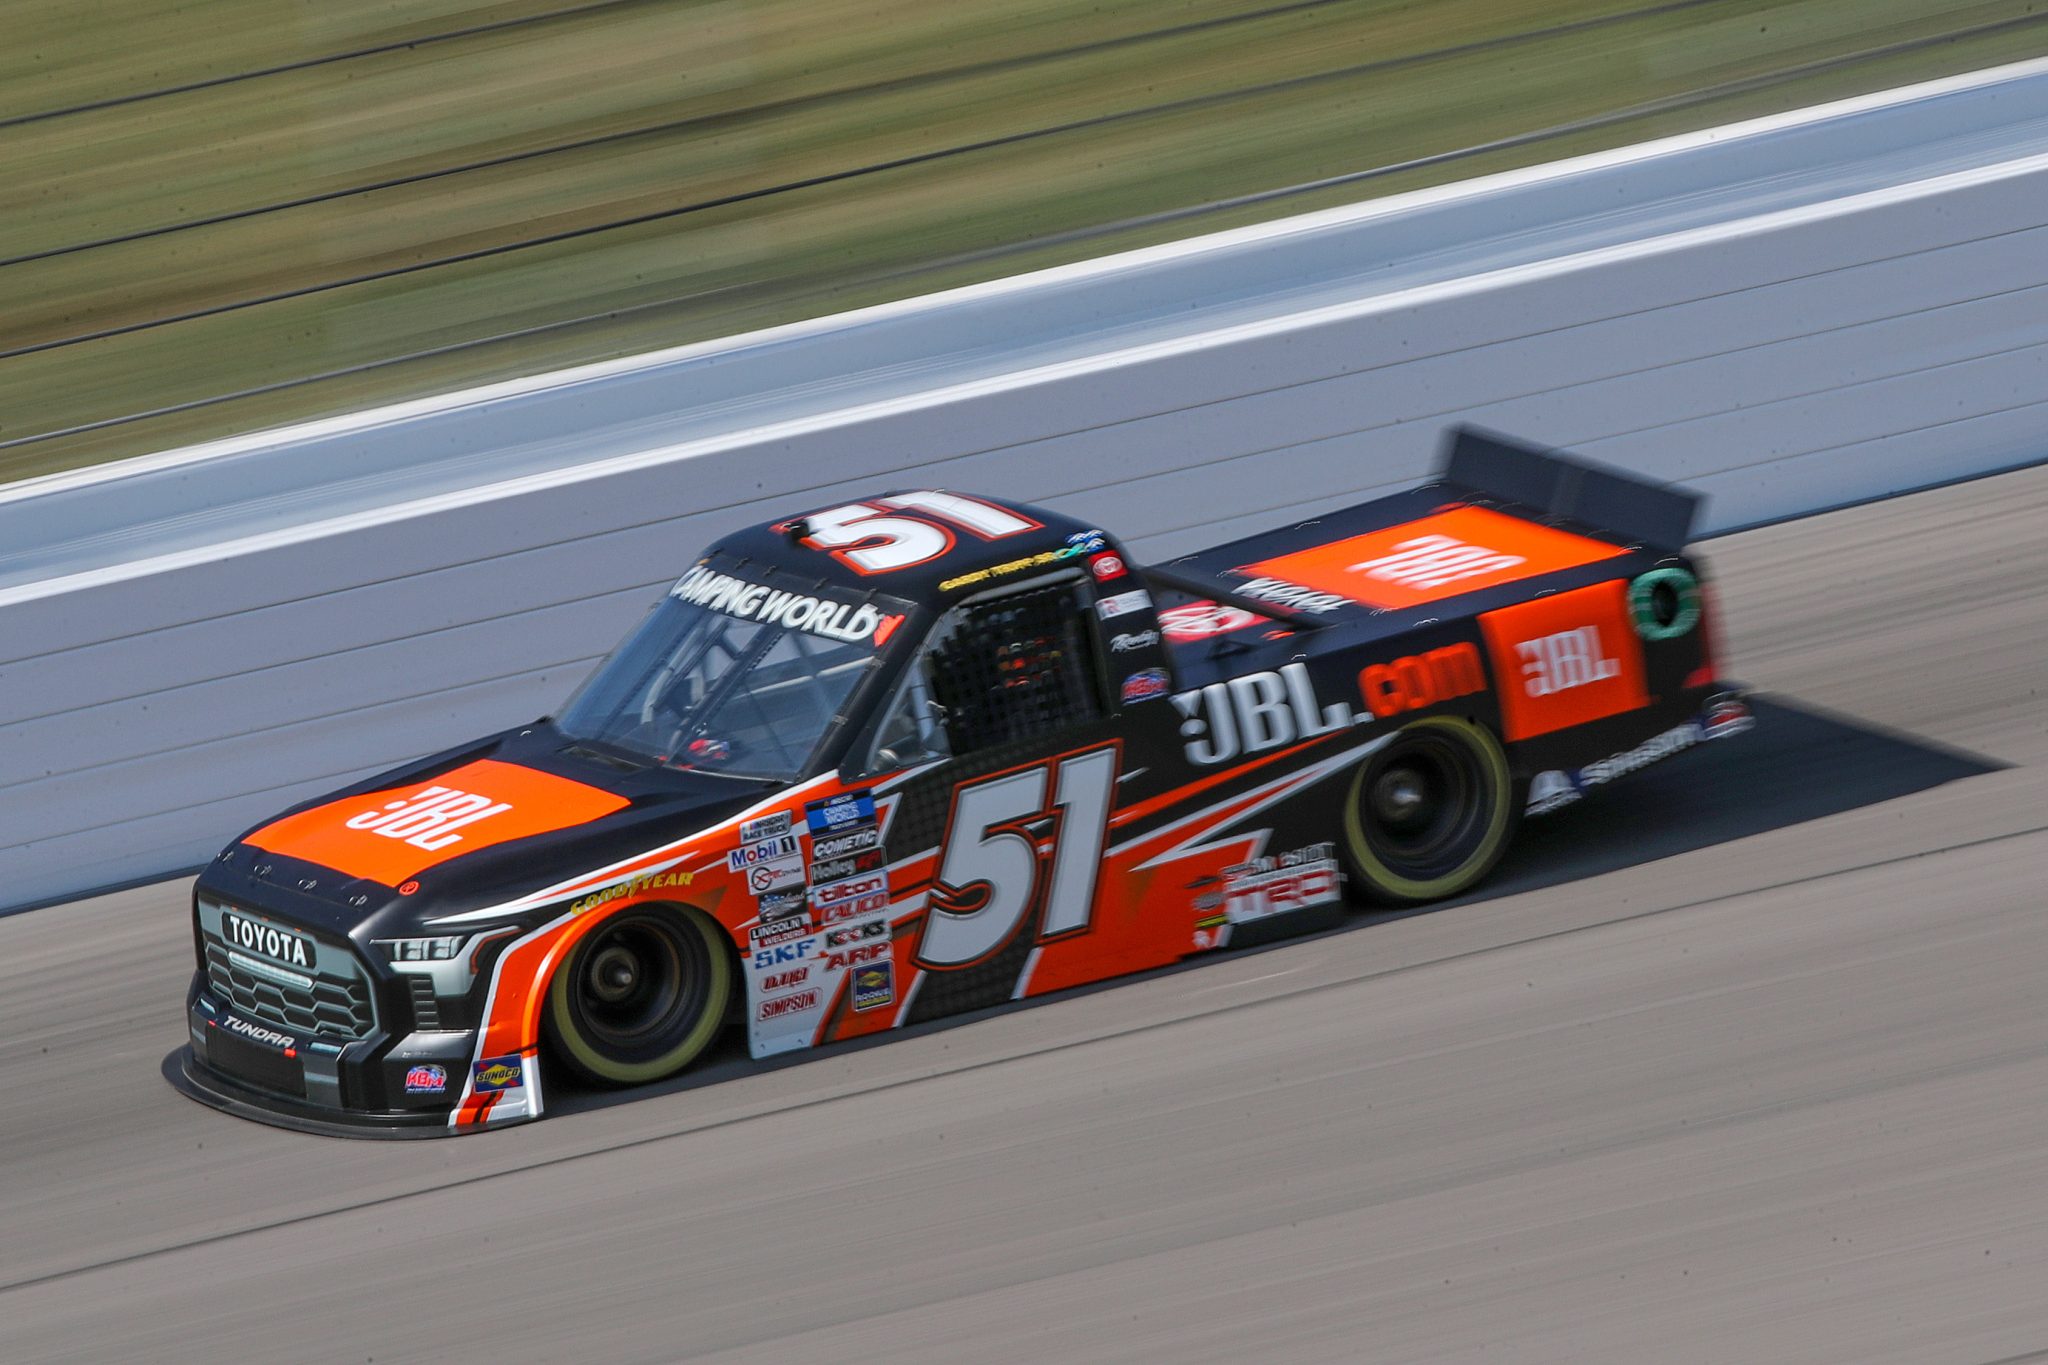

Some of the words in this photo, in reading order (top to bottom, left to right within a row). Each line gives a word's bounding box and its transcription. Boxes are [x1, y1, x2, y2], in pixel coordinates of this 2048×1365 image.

[768, 488, 1046, 577] 51
[669, 565, 772, 618] CAMPING
[755, 589, 880, 643] WORLD
[1514, 625, 1622, 698] JBL
[345, 786, 513, 851] JBL
[742, 829, 762, 840] RACE
[763, 823, 788, 837] TRUCK
[825, 809, 860, 825] WORLD
[731, 840, 777, 867] Mobil
[782, 835, 796, 852] 1
[814, 829, 878, 857] COMETIC
[909, 737, 1124, 971] 51
[570, 871, 694, 916] GOODYEAR
[230, 915, 307, 967] TOYOTA
[751, 917, 802, 940] LINCOLN
[764, 927, 807, 946] WELDERS
[755, 938, 816, 970] SKF
[825, 942, 890, 971] ARP
[760, 989, 817, 1018] SIMPSON
[223, 1014, 296, 1049] TUNDRA
[406, 1070, 445, 1088] KBM
[475, 1065, 522, 1082] SUNOCO
